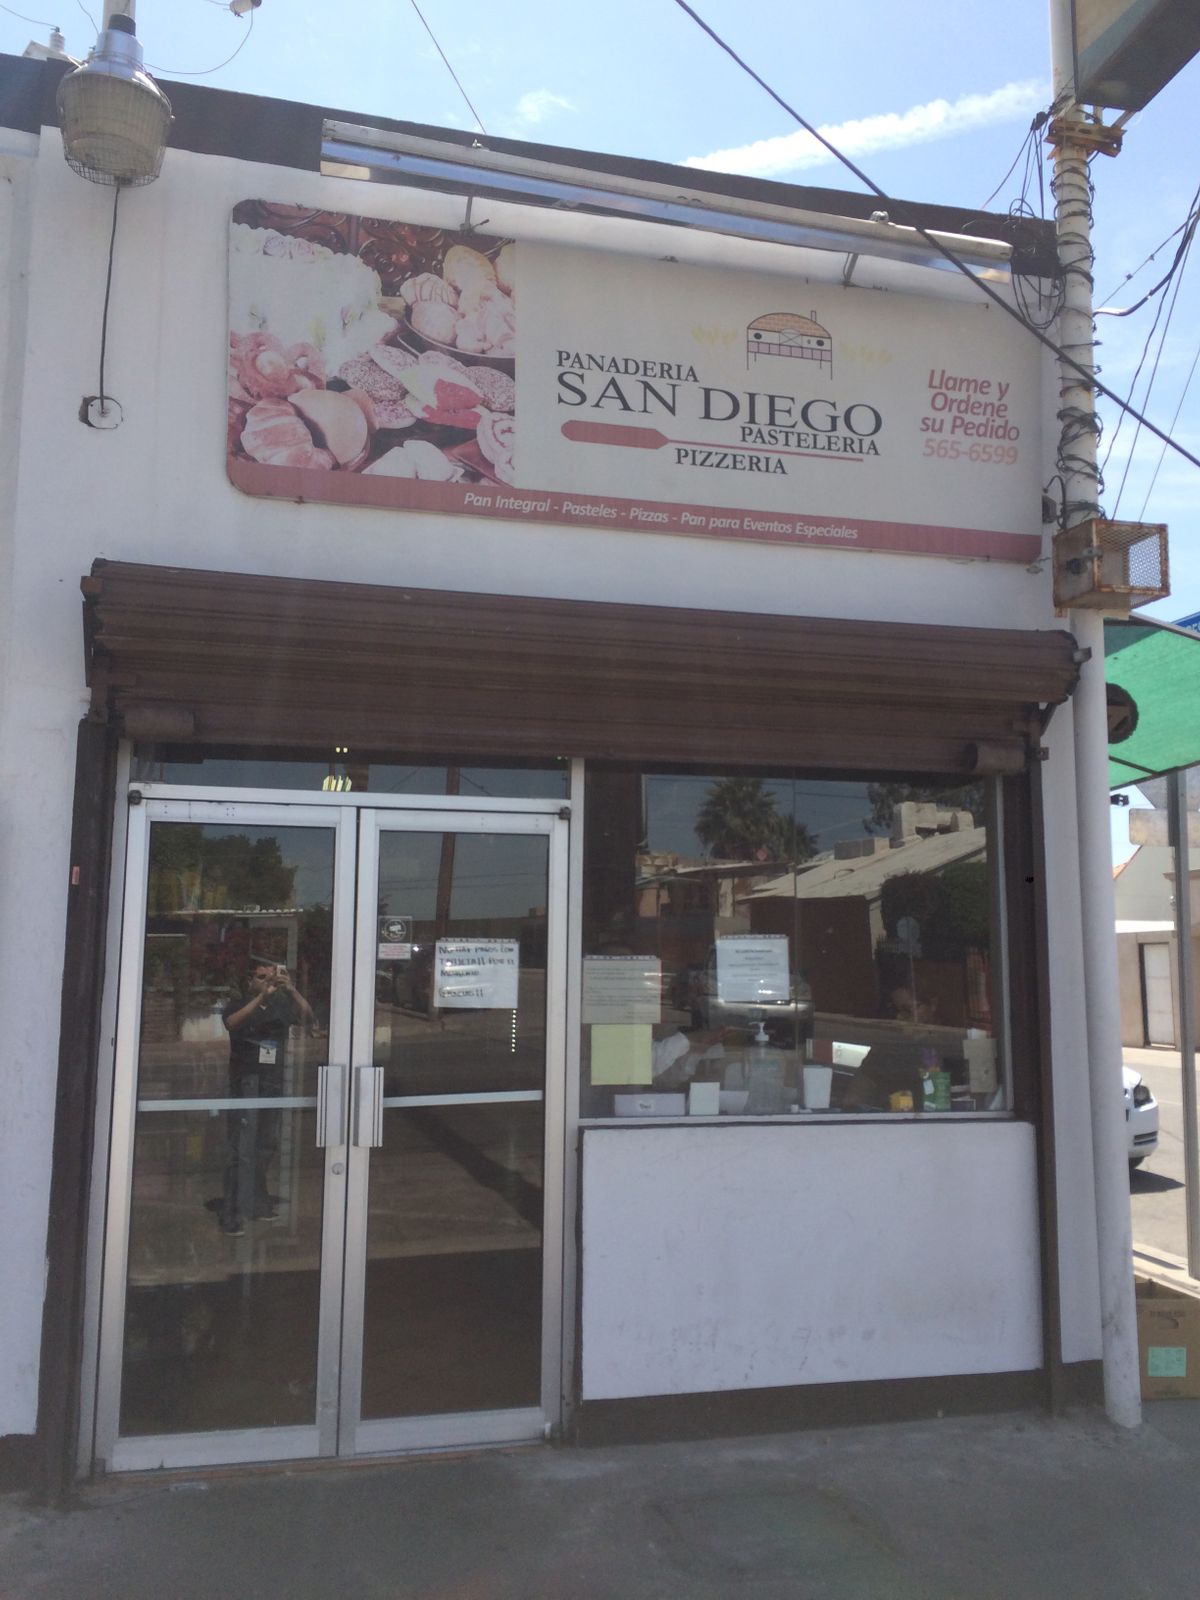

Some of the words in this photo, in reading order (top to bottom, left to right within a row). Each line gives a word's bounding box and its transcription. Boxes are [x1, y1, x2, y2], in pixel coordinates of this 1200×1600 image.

[556, 350, 700, 383] PANADERIA
[928, 369, 991, 395] Llame
[997, 381, 1010, 401] y
[557, 371, 681, 417] SAN
[698, 386, 883, 437] DIEGO
[930, 391, 1008, 418] Ordene
[739, 425, 881, 456] PASTELERIA
[920, 416, 944, 433] su
[950, 415, 1020, 441] Pedido
[675, 447, 788, 475] PIZZERIA
[922, 437, 1018, 465] 565-6599
[464, 492, 491, 508] Pan
[495, 496, 550, 514] Integral
[562, 501, 618, 519] Pasteles
[629, 507, 669, 524] Pizzas
[681, 512, 705, 526] Pan
[709, 517, 740, 530] para
[743, 517, 792, 534] Eventos
[795, 522, 859, 540] Especiales
